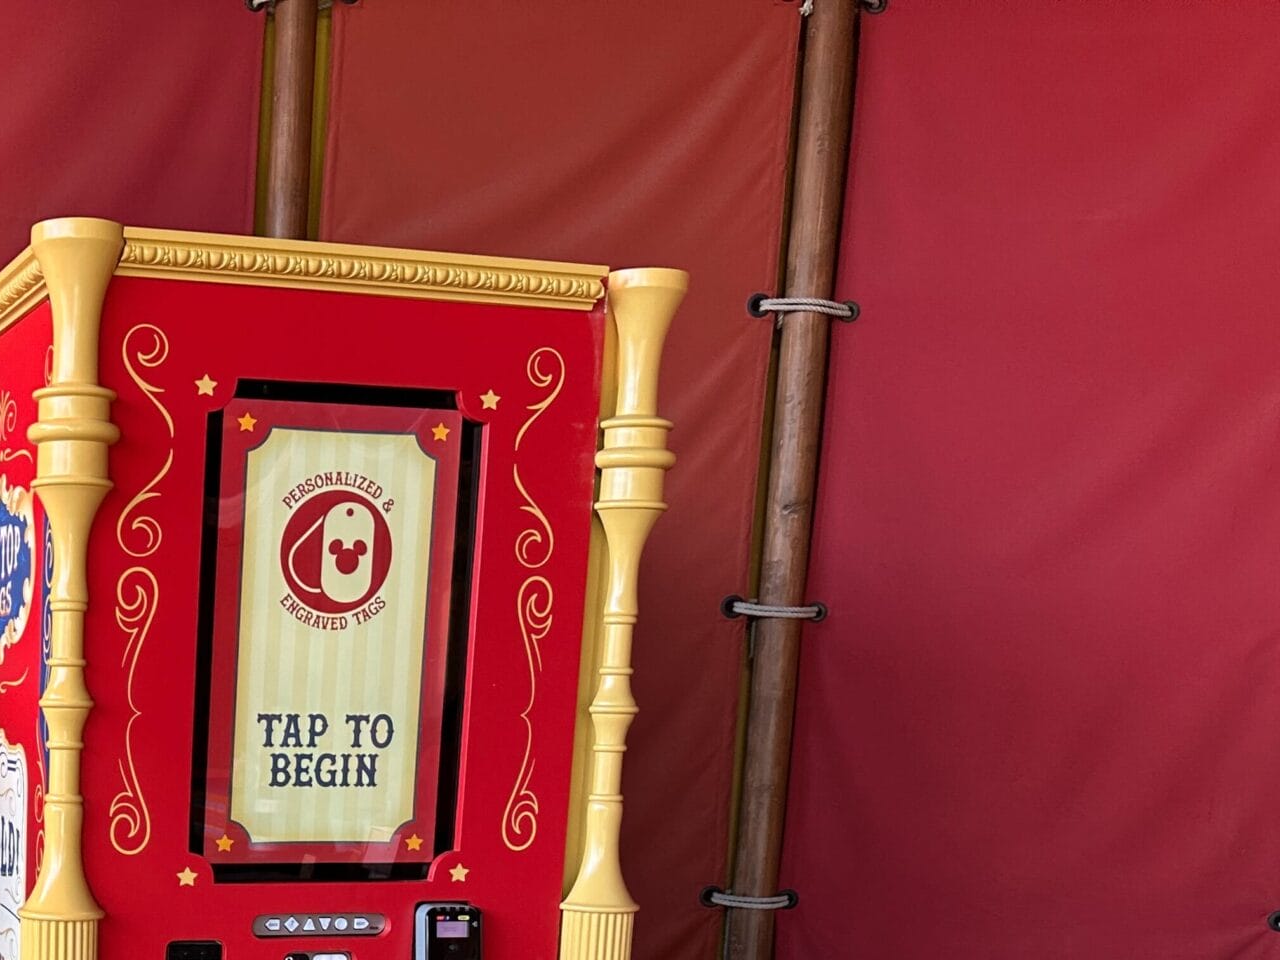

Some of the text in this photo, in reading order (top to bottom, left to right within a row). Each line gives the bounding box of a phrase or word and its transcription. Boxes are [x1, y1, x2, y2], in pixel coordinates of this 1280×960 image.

[282, 471, 395, 514] PERSONALIZED &
[0, 523, 21, 580] TOP
[279, 593, 386, 631] ENGRAVED TAGS
[256, 713, 395, 748] TAP TO
[268, 753, 379, 788] BEGIN
